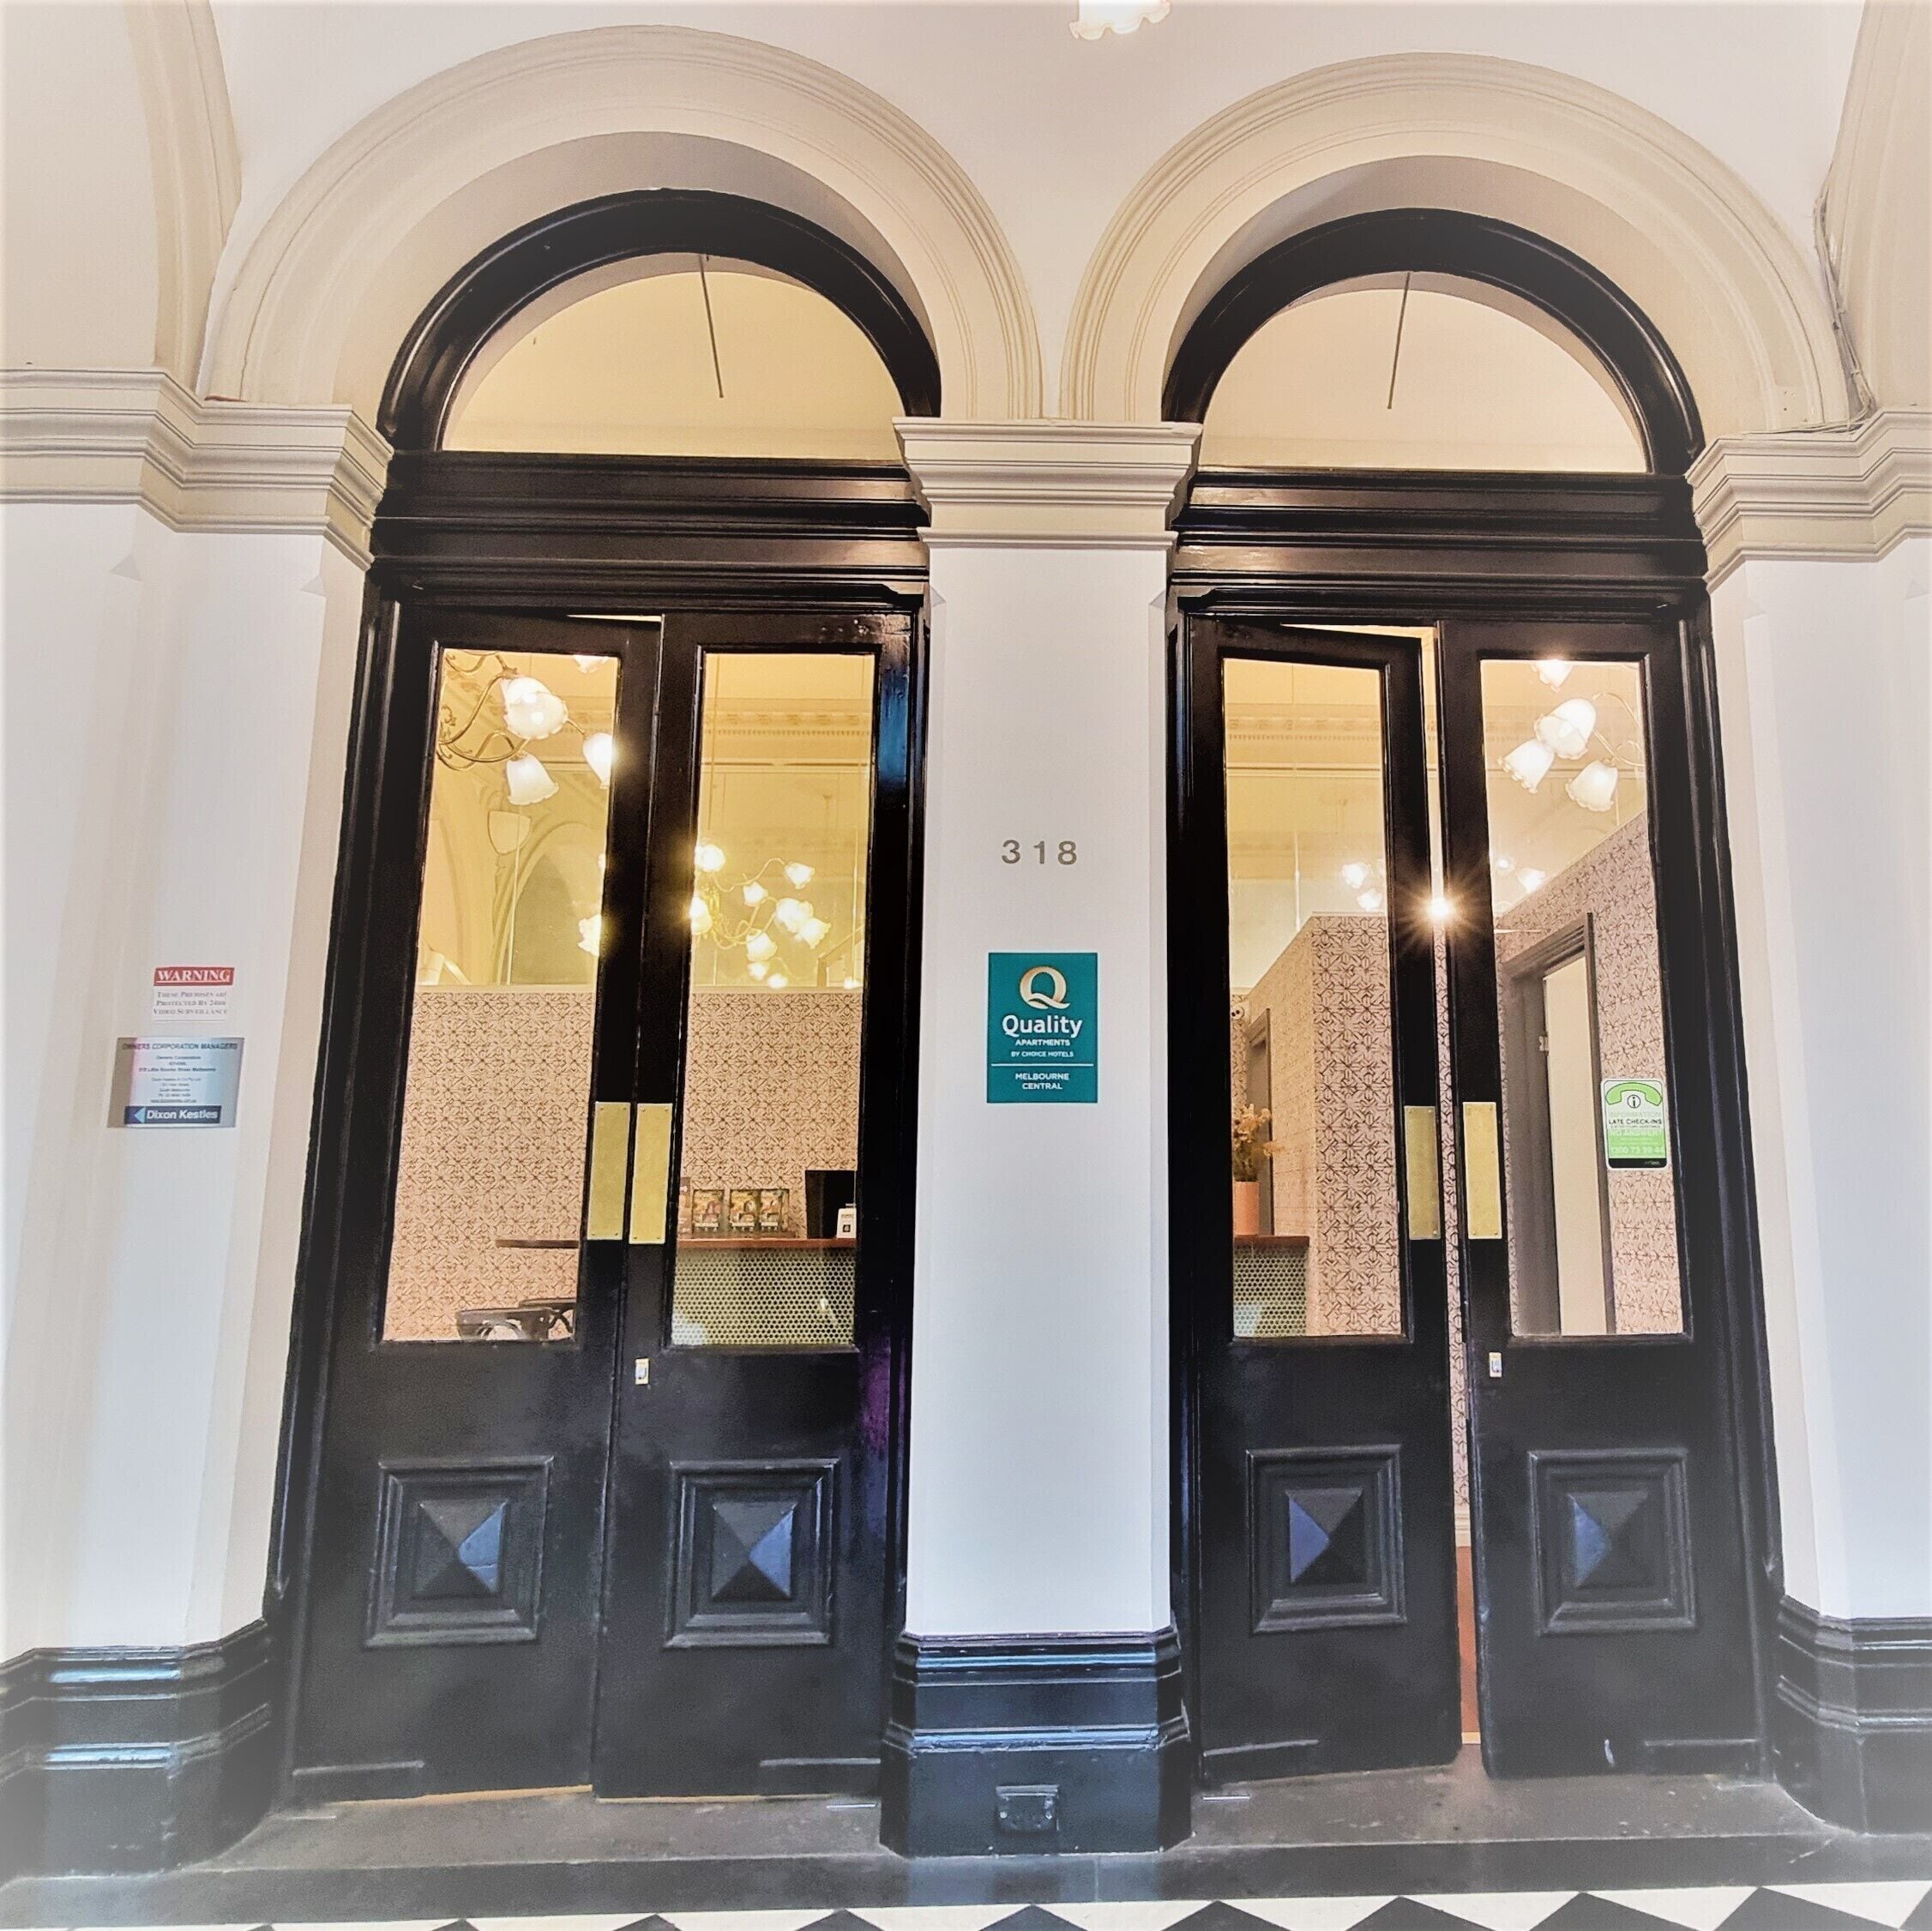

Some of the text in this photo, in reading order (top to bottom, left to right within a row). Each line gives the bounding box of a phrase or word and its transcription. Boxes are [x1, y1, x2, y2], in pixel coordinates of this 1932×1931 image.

[1002, 839, 1078, 865] 318
[157, 969, 232, 983] WARNING
[1002, 1014, 1083, 1038] Quality
[146, 1109, 178, 1120] Dixon
